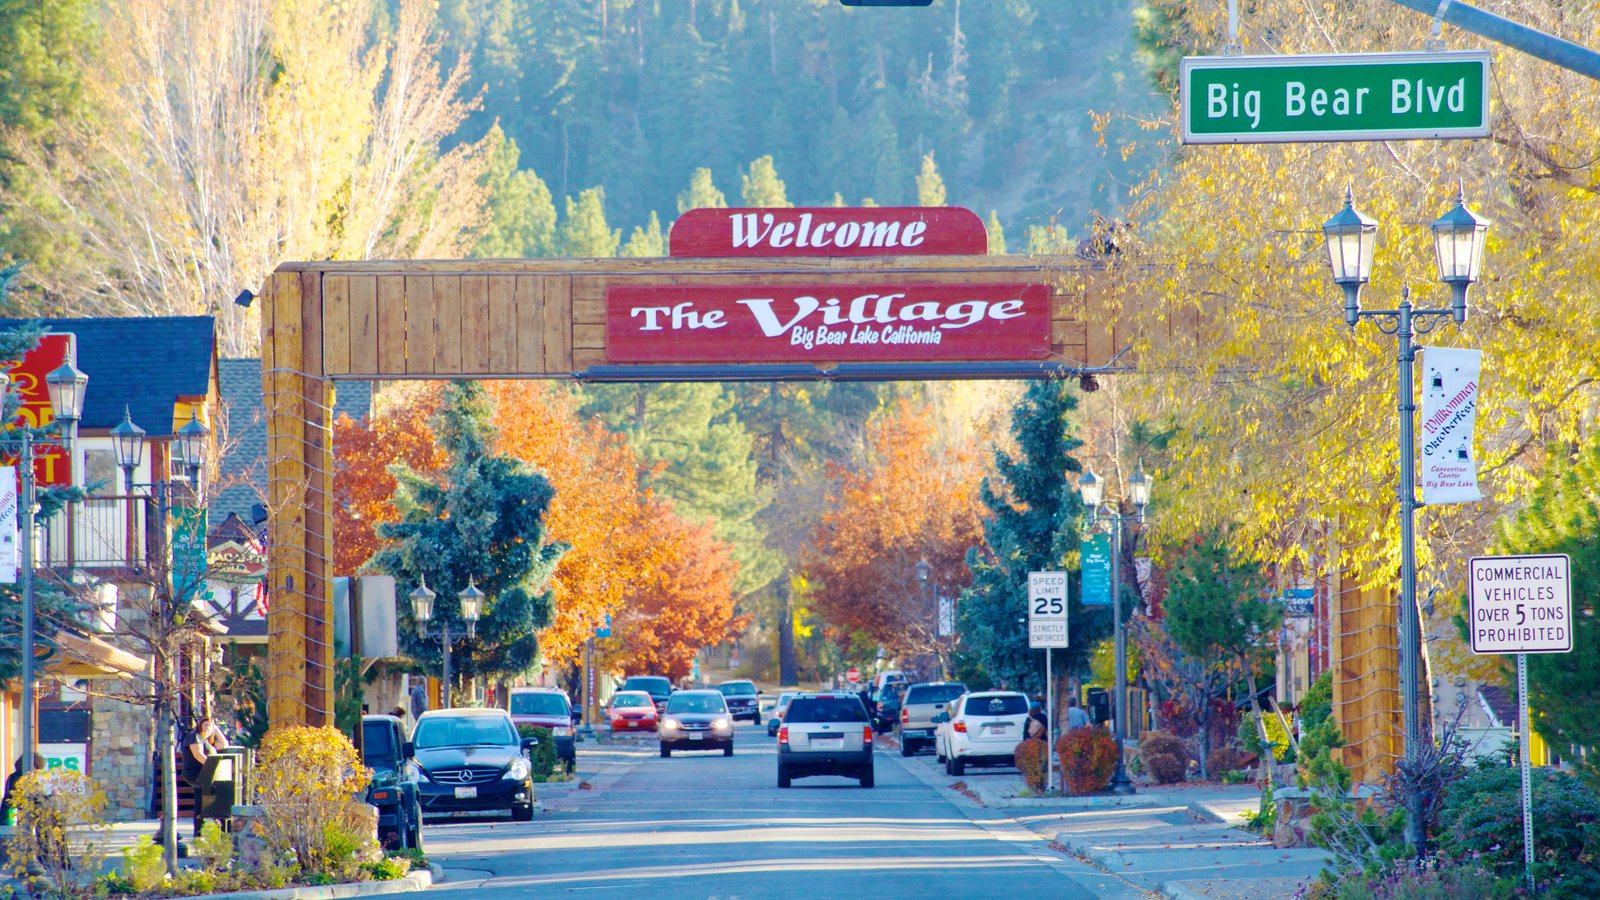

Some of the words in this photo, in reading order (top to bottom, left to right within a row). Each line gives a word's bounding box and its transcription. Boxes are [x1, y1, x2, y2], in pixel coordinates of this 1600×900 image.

[1207, 82, 1261, 130] Big
[1286, 81, 1370, 117] Bear
[1391, 77, 1466, 114] Blvd
[729, 212, 927, 249] Welcome
[629, 301, 728, 332] The
[736, 293, 1027, 338] Village
[791, 325, 813, 350] Big
[816, 324, 848, 346] Bear
[850, 323, 880, 345] Lake
[882, 323, 942, 346] California
[1423, 381, 1477, 435] Willkommen
[1424, 400, 1475, 457] Oktoberfest
[1430, 465, 1467, 473] Convention
[1437, 472, 1461, 480] Center
[1426, 481, 1438, 489] Big
[1440, 480, 1456, 488] Bear
[1458, 480, 1473, 488] Lake
[1032, 577, 1064, 586] SPEED
[1476, 566, 1563, 582] COMMERCIAL
[1036, 587, 1060, 595] LIMIT
[1484, 586, 1555, 601] VEHICLES
[1034, 597, 1063, 615] 25
[1478, 607, 1510, 622] OVER
[1516, 603, 1526, 626] 5
[1530, 606, 1564, 621] TONS
[1033, 625, 1064, 633] STRICTLY
[1478, 625, 1565, 642] PROHIBITED
[1032, 634, 1065, 642] ENFORCED
